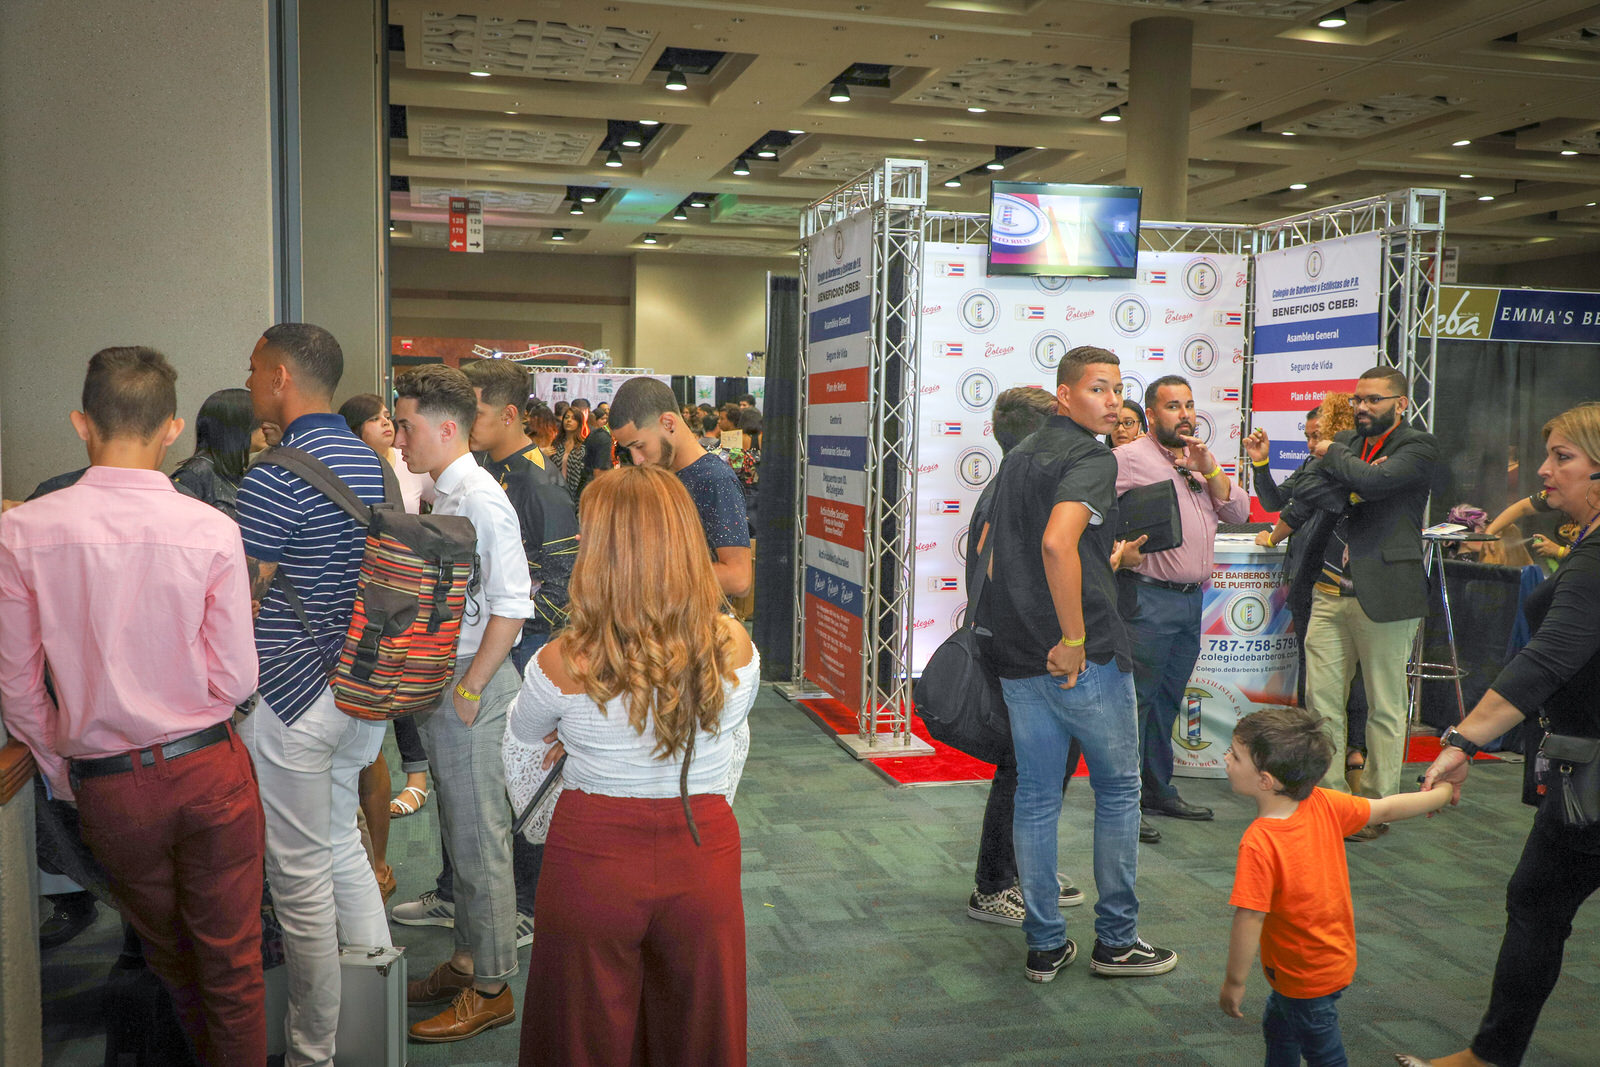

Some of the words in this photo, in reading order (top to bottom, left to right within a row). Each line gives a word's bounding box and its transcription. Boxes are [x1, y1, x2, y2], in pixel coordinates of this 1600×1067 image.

[818, 285, 844, 302] BENEFICIOS
[1272, 289, 1289, 299] Colegio
[1289, 287, 1296, 296] de
[1296, 284, 1317, 295] Barberos
[1321, 279, 1343, 292] Estilistas
[1343, 278, 1350, 287] de
[1272, 302, 1325, 317] BENEFICIOS
[1328, 298, 1358, 311] CBEB:
[1065, 309, 1095, 321] Colegio
[1165, 313, 1193, 324] Colegio
[1500, 307, 1574, 325] EMMA'S
[1286, 332, 1314, 343] Asamblea
[1315, 329, 1339, 340] General
[984, 346, 1015, 358] Colegio
[1290, 362, 1311, 374] Seguro
[1311, 361, 1319, 370] de
[1319, 360, 1333, 370] Vida
[1290, 392, 1304, 401] Plan
[1304, 391, 1312, 400] de
[1211, 571, 1224, 579] DE
[1225, 571, 1270, 580] BARBEROS
[1271, 571, 1278, 579] Y
[1214, 581, 1226, 589] DE
[1228, 581, 1262, 589] PUERTO
[1263, 581, 1281, 589] RICO
[1208, 637, 1298, 652] 787-758-5790
[1195, 677, 1236, 703] ESTILISTAS
